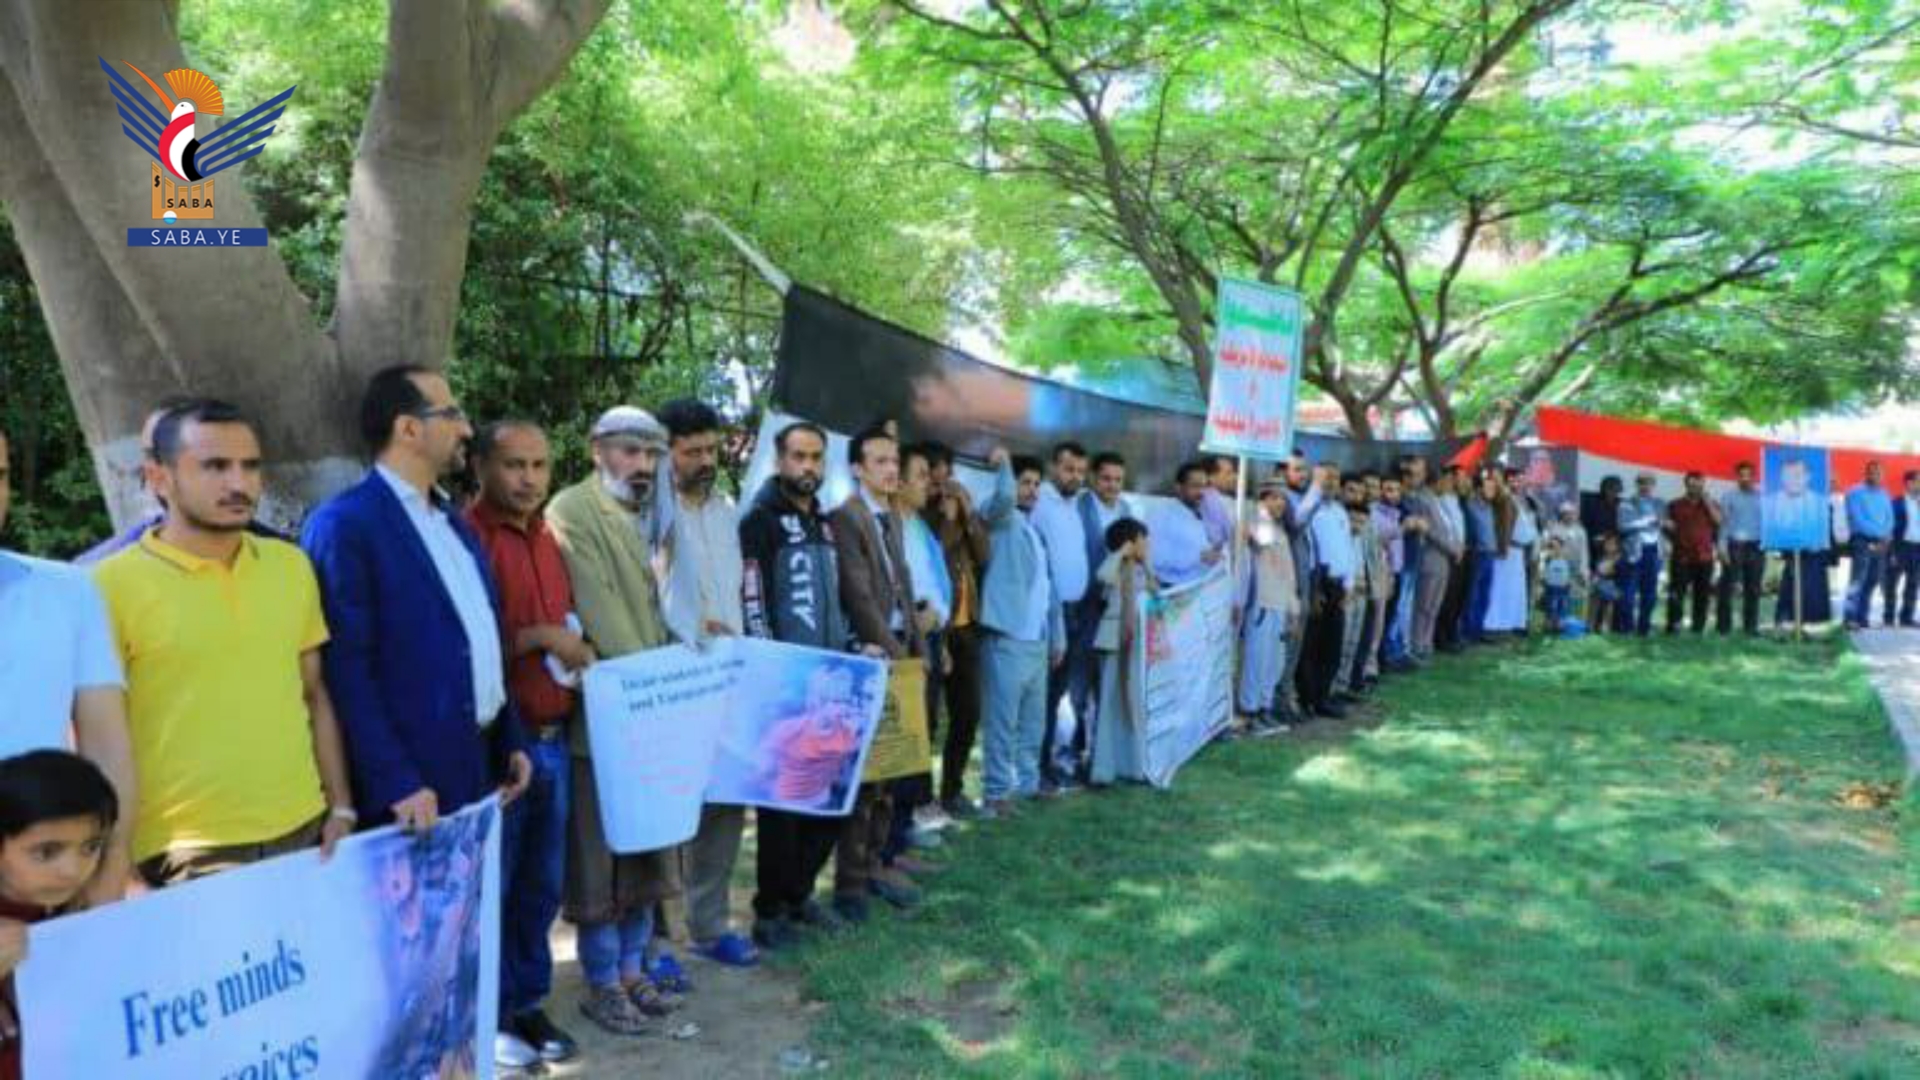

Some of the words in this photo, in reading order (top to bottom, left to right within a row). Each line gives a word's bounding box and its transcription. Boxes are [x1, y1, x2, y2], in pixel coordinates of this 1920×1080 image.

[121, 990, 208, 1060] Free
[216, 939, 306, 1017] minds
[220, 1034, 319, 1080] ices
